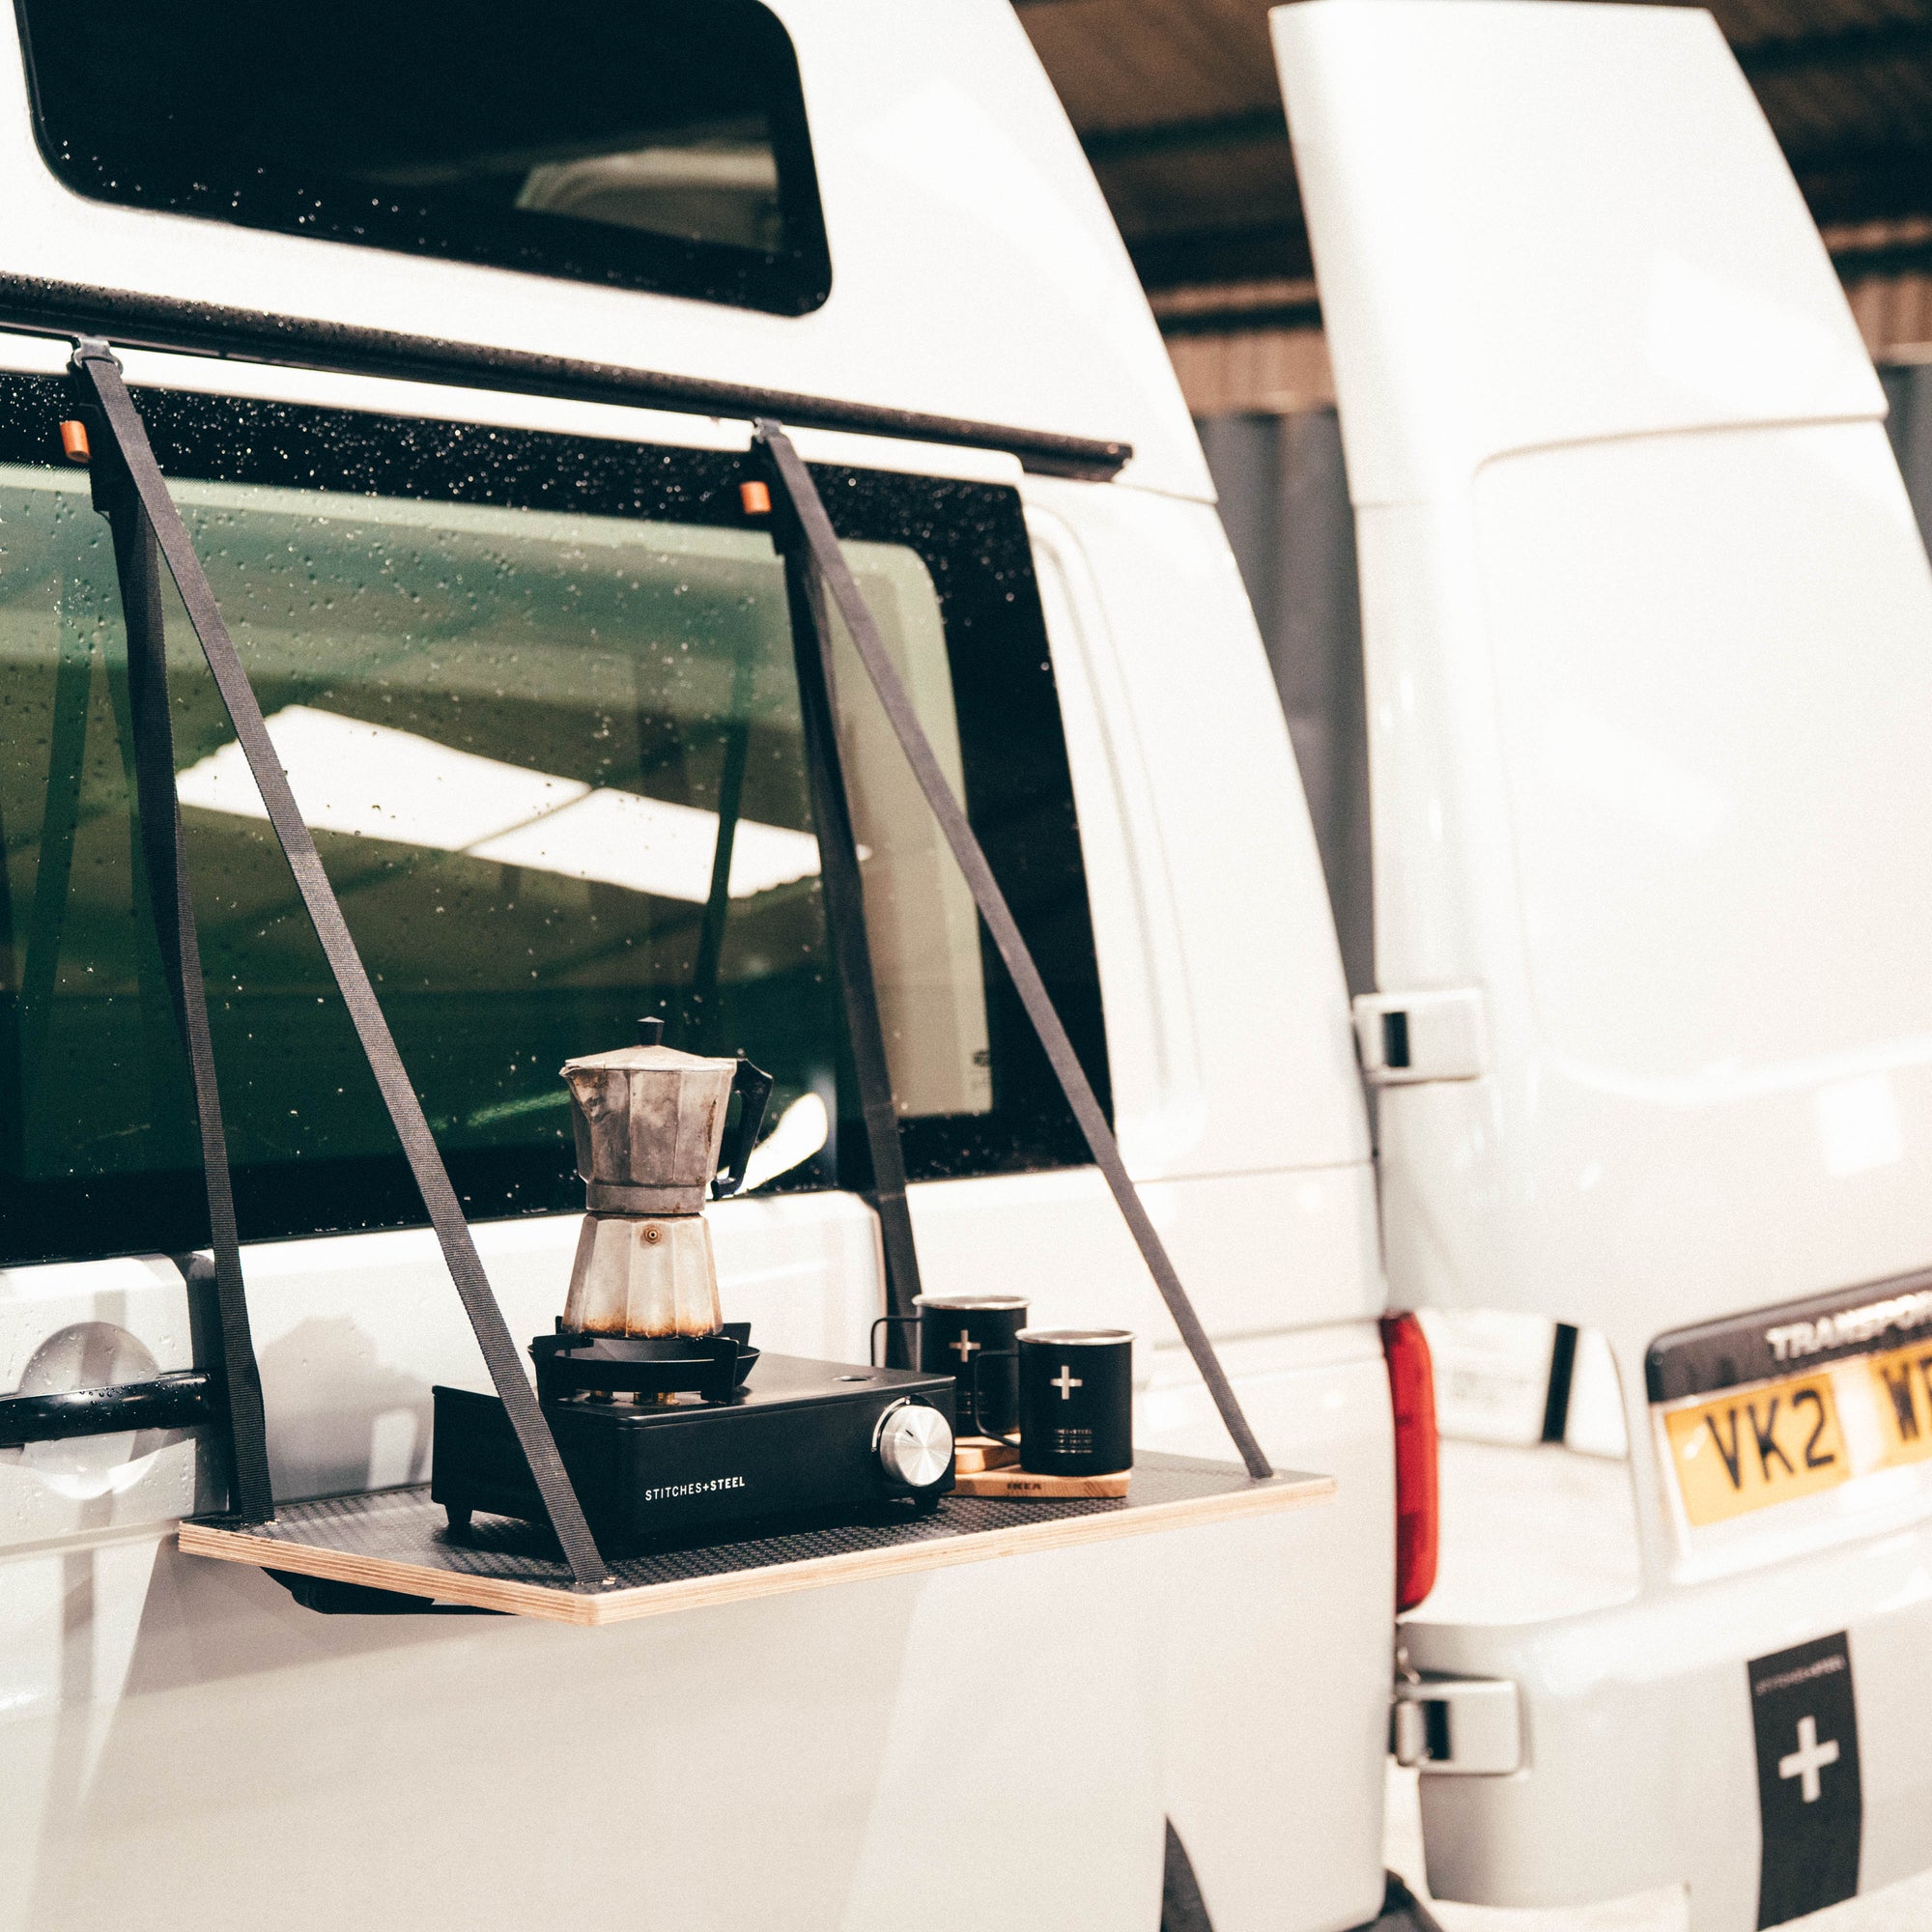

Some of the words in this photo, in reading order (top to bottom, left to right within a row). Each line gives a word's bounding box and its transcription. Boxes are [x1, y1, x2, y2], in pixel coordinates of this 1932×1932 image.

[1705, 1389, 1834, 1490] VK2
[645, 1476, 745, 1500] STITCHES+STEEL
[1007, 1482, 1041, 1491] IKEA
